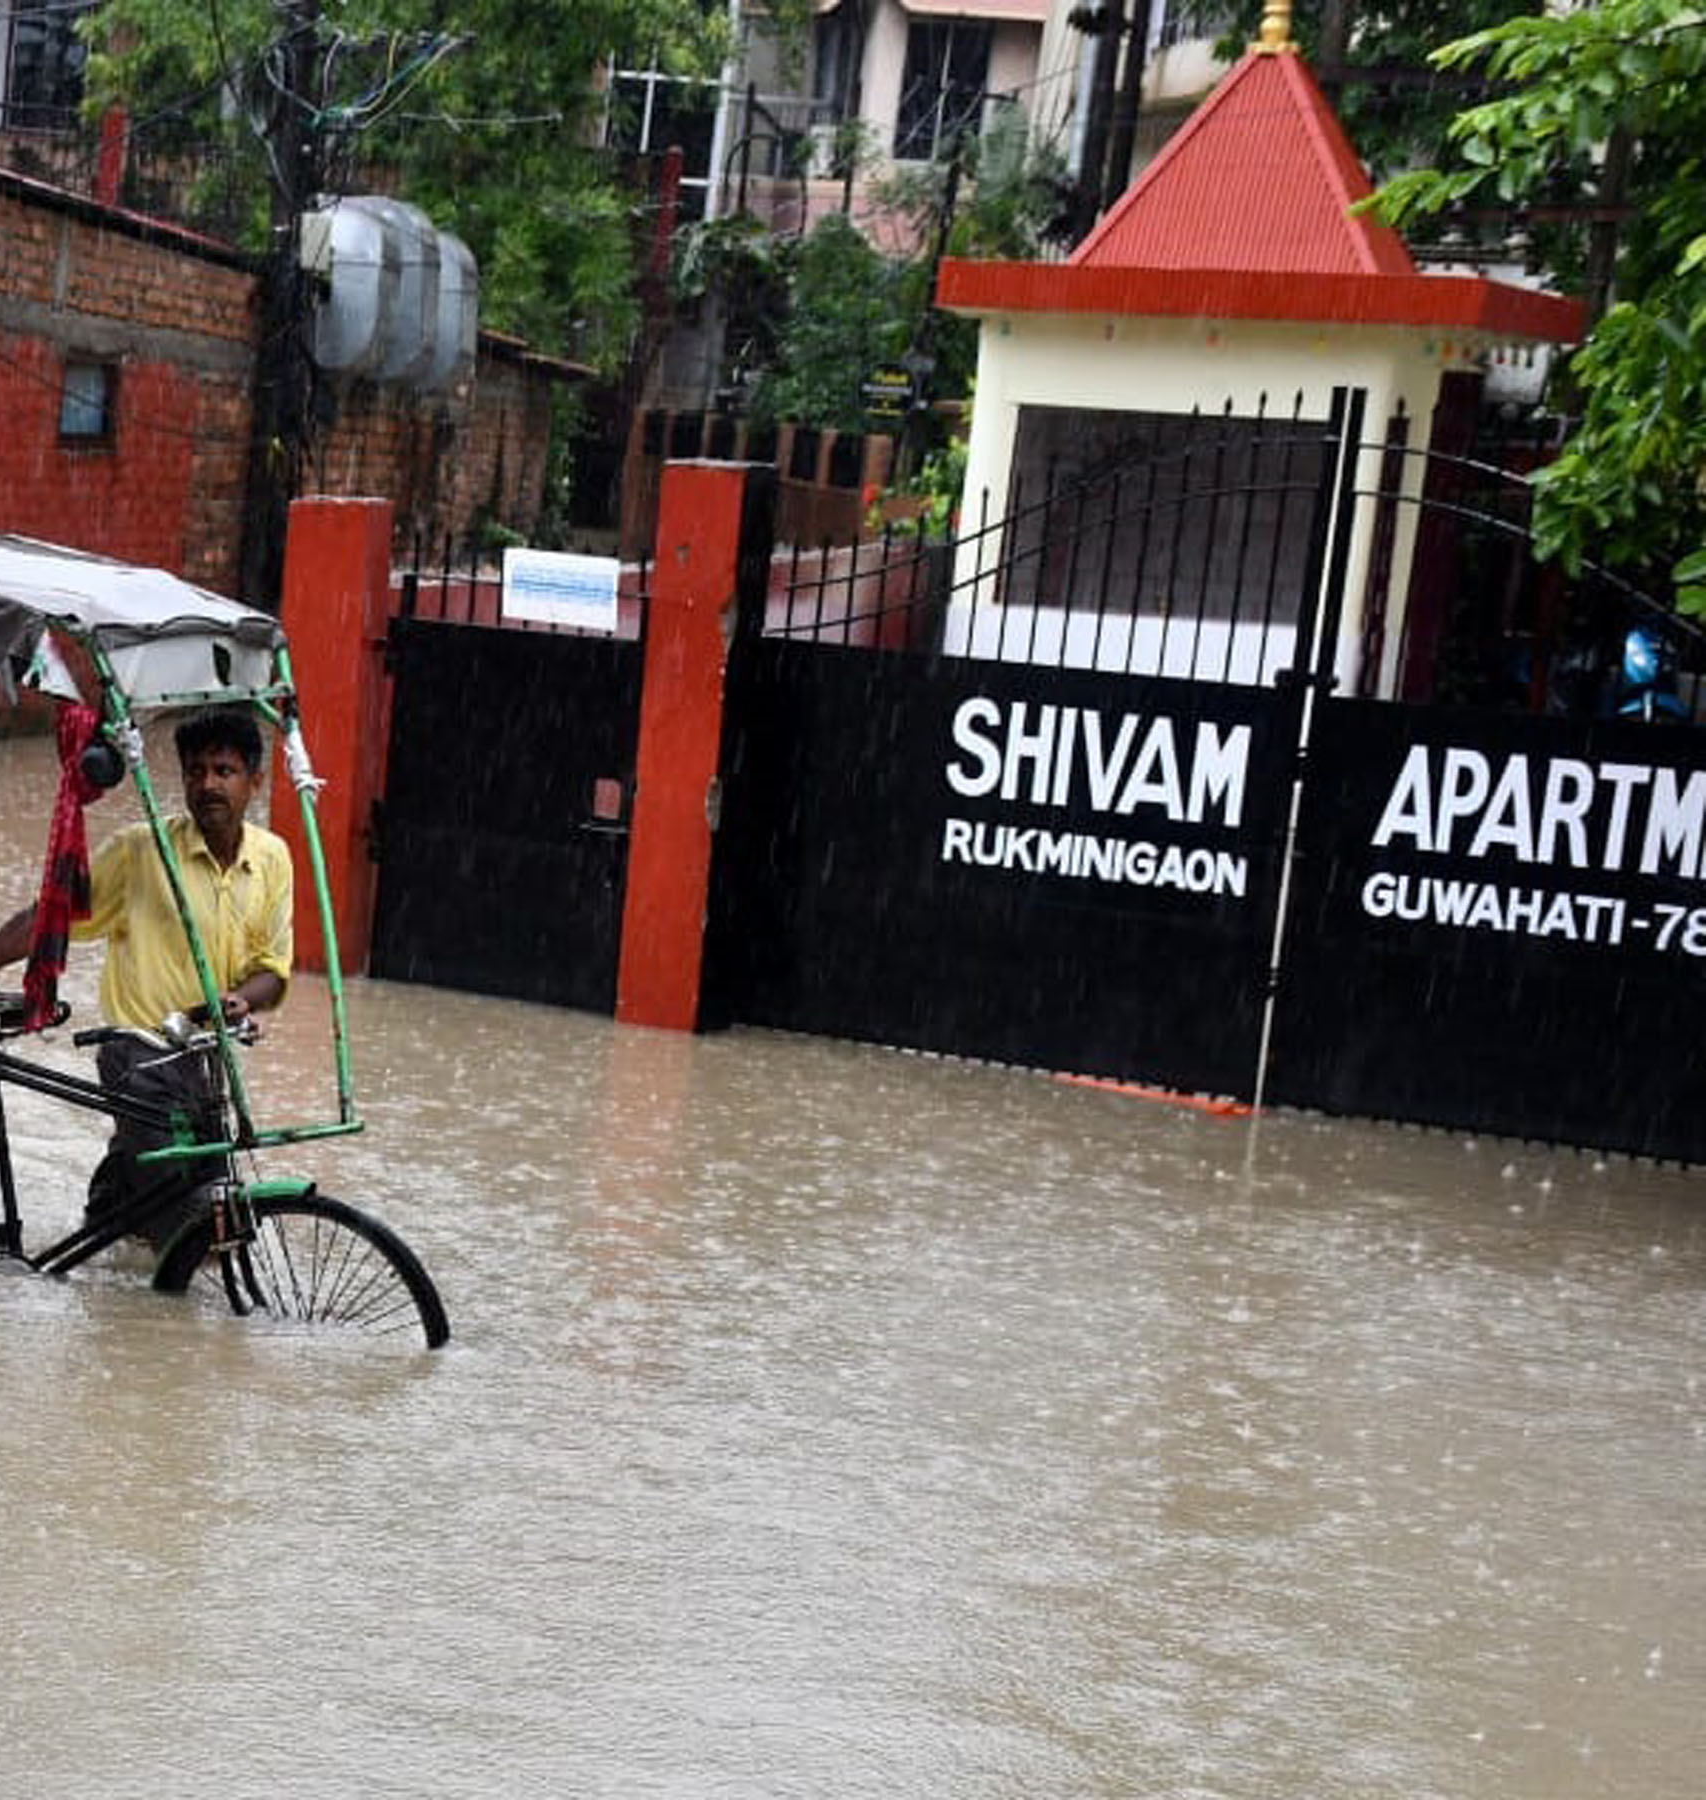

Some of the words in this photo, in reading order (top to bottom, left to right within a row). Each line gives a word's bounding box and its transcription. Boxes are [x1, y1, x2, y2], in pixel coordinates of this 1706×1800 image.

[946, 696, 1252, 828] SHIVAM
[1371, 744, 1706, 880] APARTM
[942, 818, 1247, 897] RUKMINIGAON
